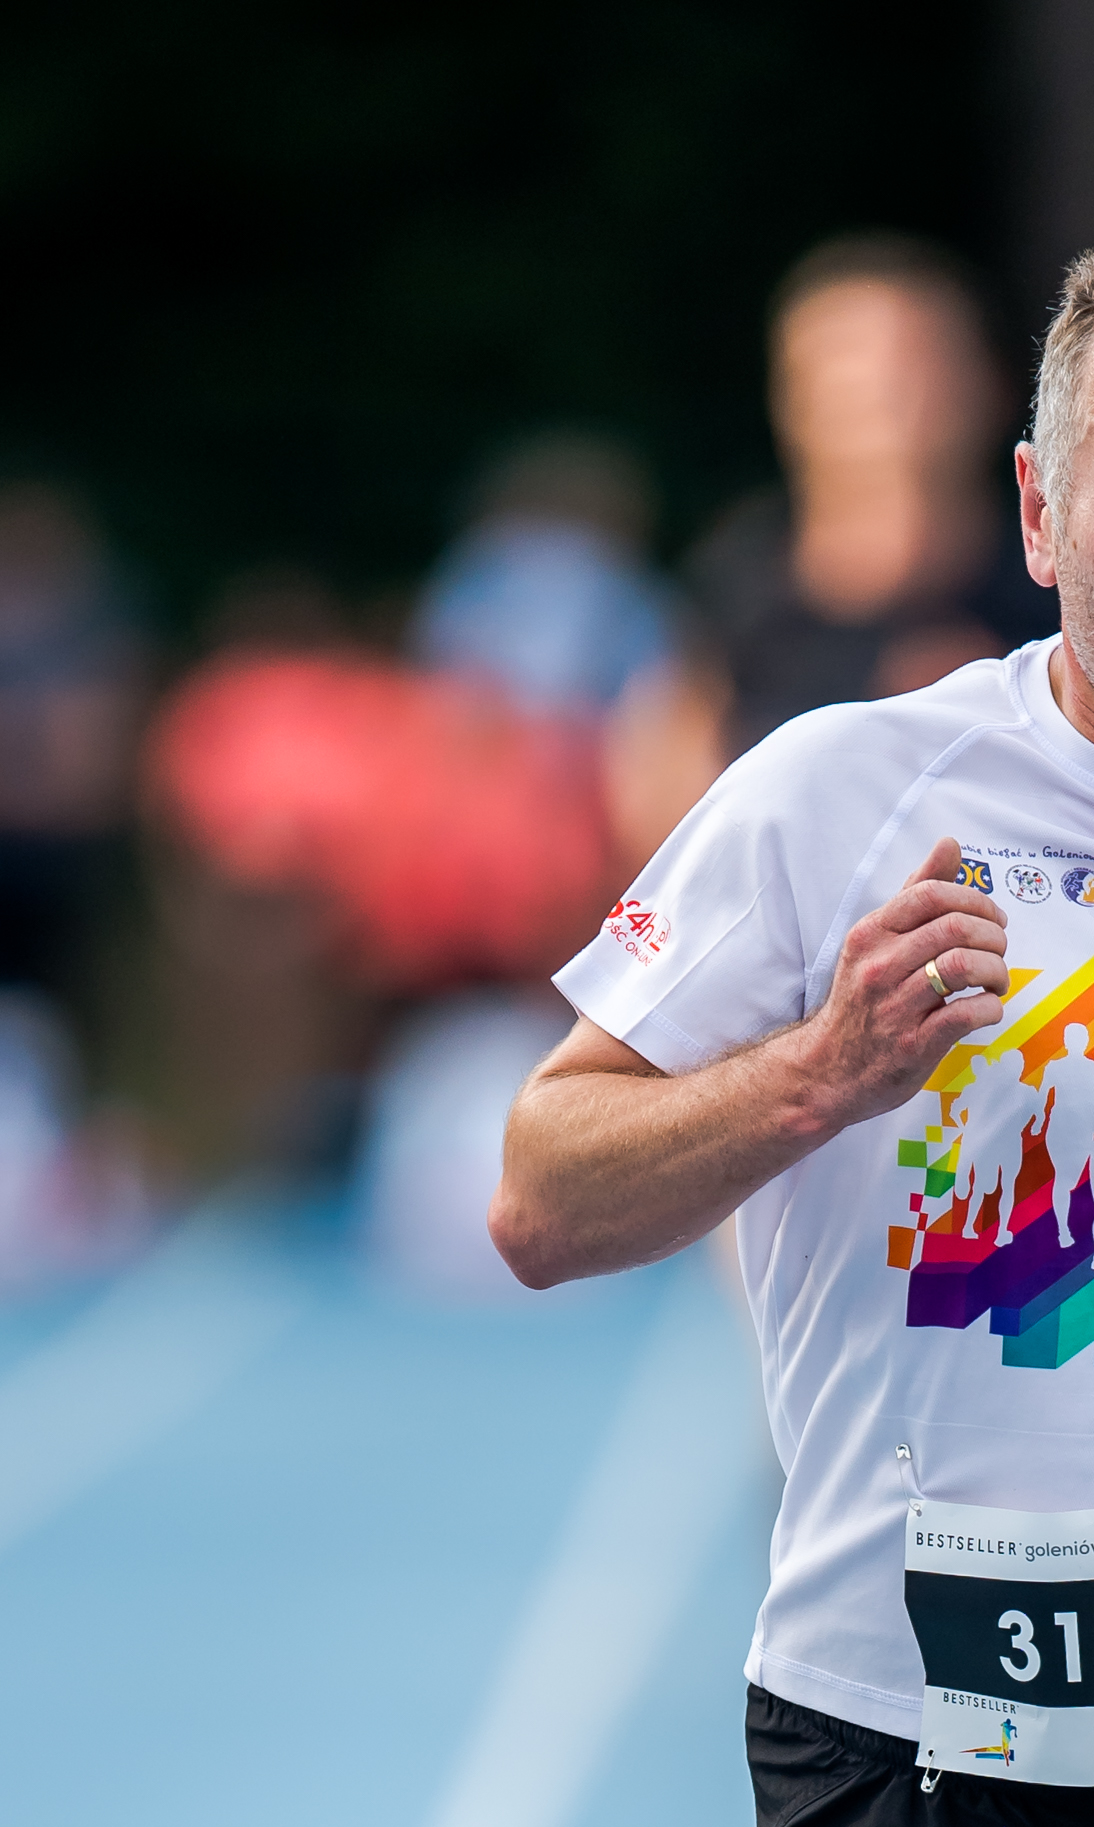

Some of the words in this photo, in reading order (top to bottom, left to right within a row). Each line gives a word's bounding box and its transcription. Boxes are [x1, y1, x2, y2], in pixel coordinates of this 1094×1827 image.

[961, 844, 983, 856] ubię
[915, 1530, 1018, 1556] BESTSELLER
[942, 1691, 1018, 1715] BESTSELLER
